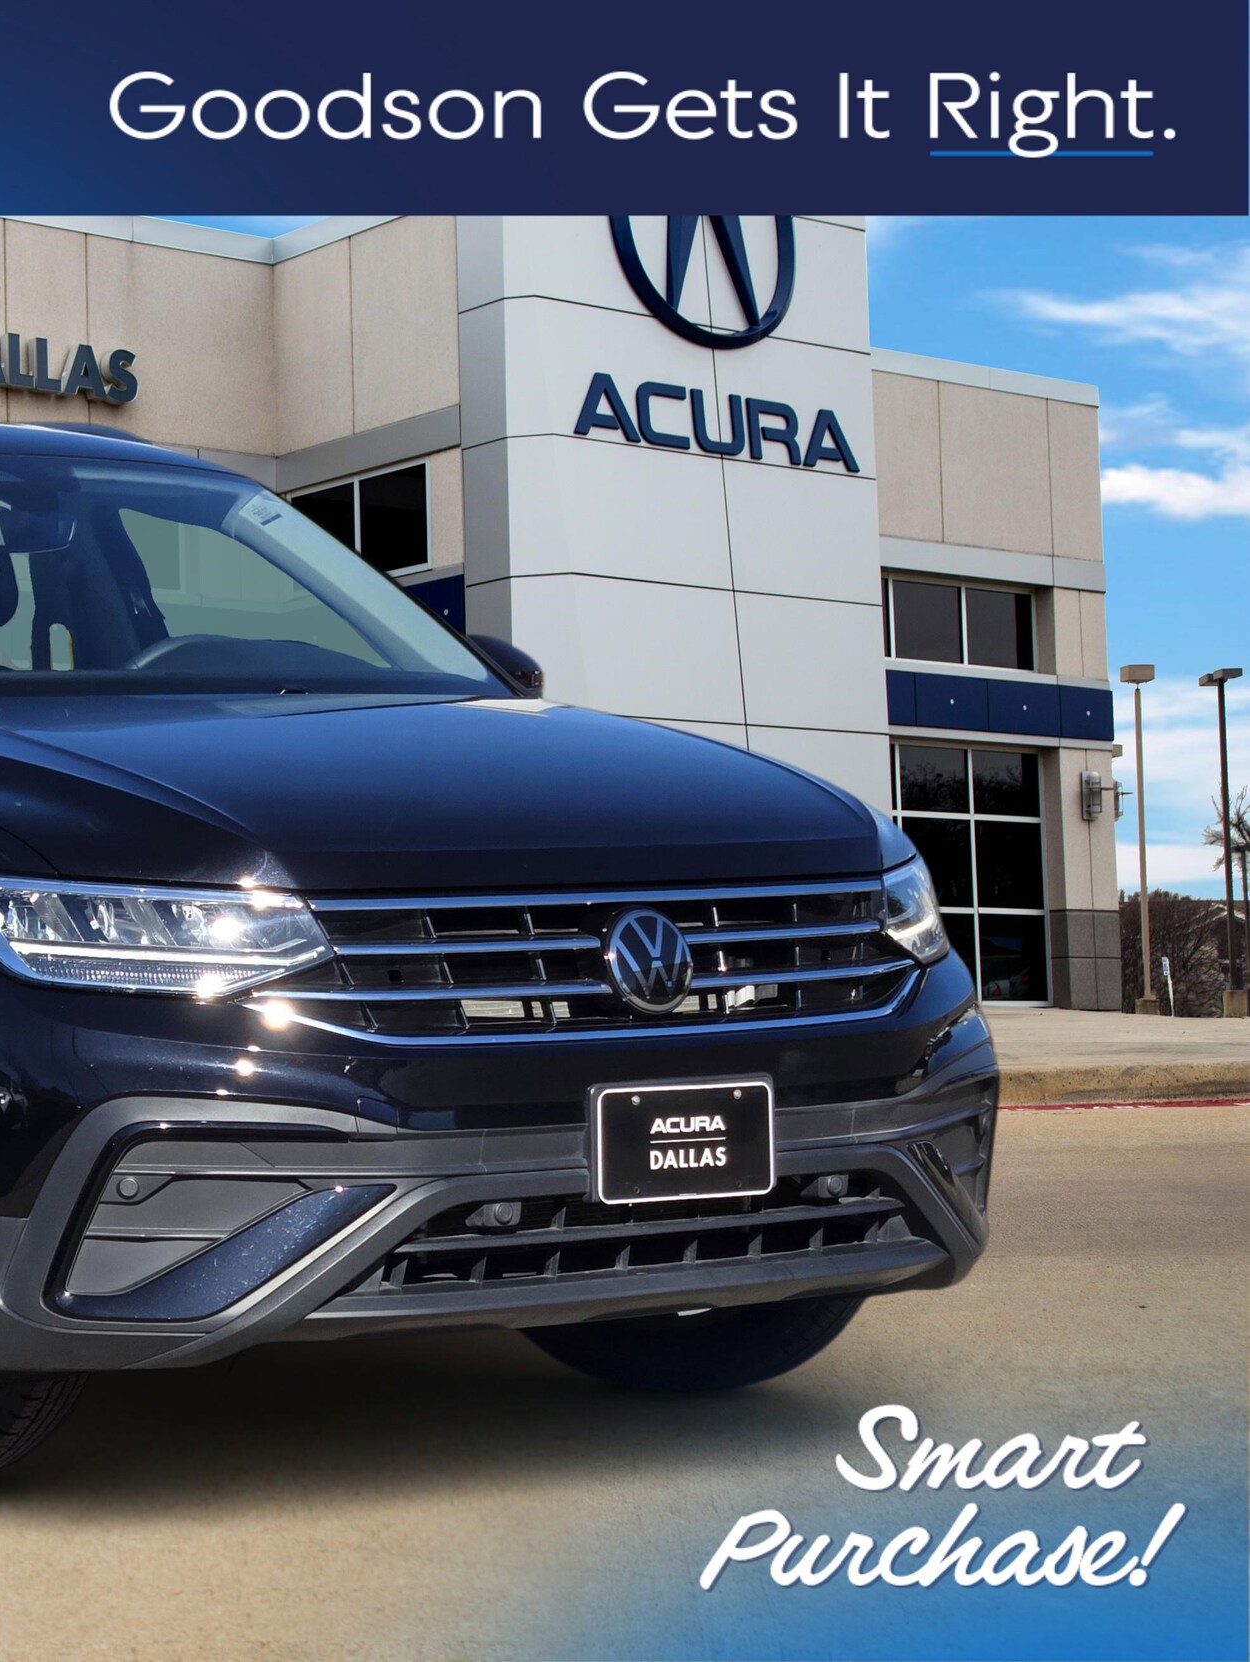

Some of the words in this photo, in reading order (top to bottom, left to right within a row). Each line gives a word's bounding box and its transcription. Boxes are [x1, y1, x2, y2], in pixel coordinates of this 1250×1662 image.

[573, 371, 860, 473] ACURA
[650, 1115, 726, 1134] ACURA
[649, 1146, 727, 1170] DALLAS
